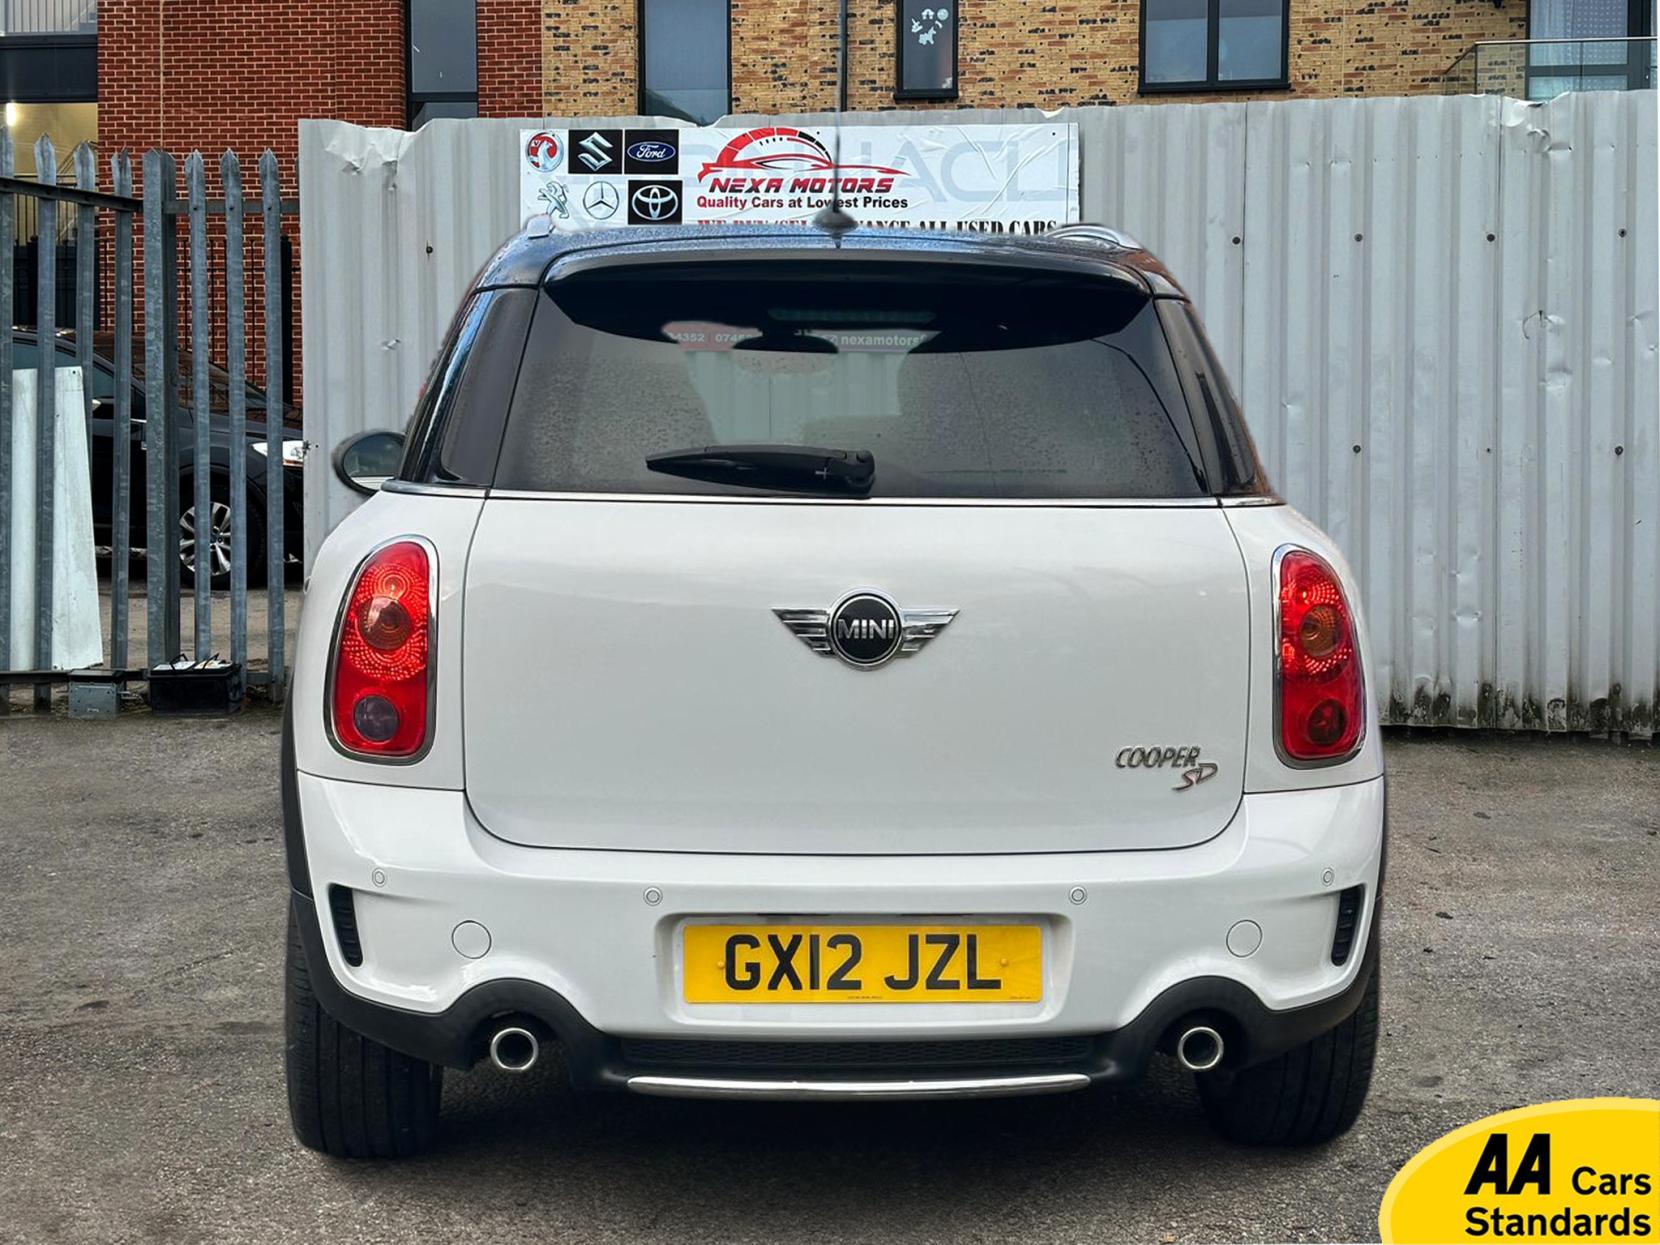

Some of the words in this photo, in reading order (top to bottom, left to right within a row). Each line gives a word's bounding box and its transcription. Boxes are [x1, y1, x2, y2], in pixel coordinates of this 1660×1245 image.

[637, 144, 665, 158] Ford
[709, 178, 783, 193] NEXA
[789, 178, 894, 193] MOTORS
[697, 196, 746, 210] Quality
[752, 196, 783, 208] Cars
[788, 197, 802, 208] at
[863, 196, 908, 208] Prices
[838, 619, 894, 639] MINI
[1115, 746, 1201, 768] COOPER
[1171, 763, 1218, 791] SD
[725, 934, 862, 991] GX12
[884, 934, 1001, 991] JZL
